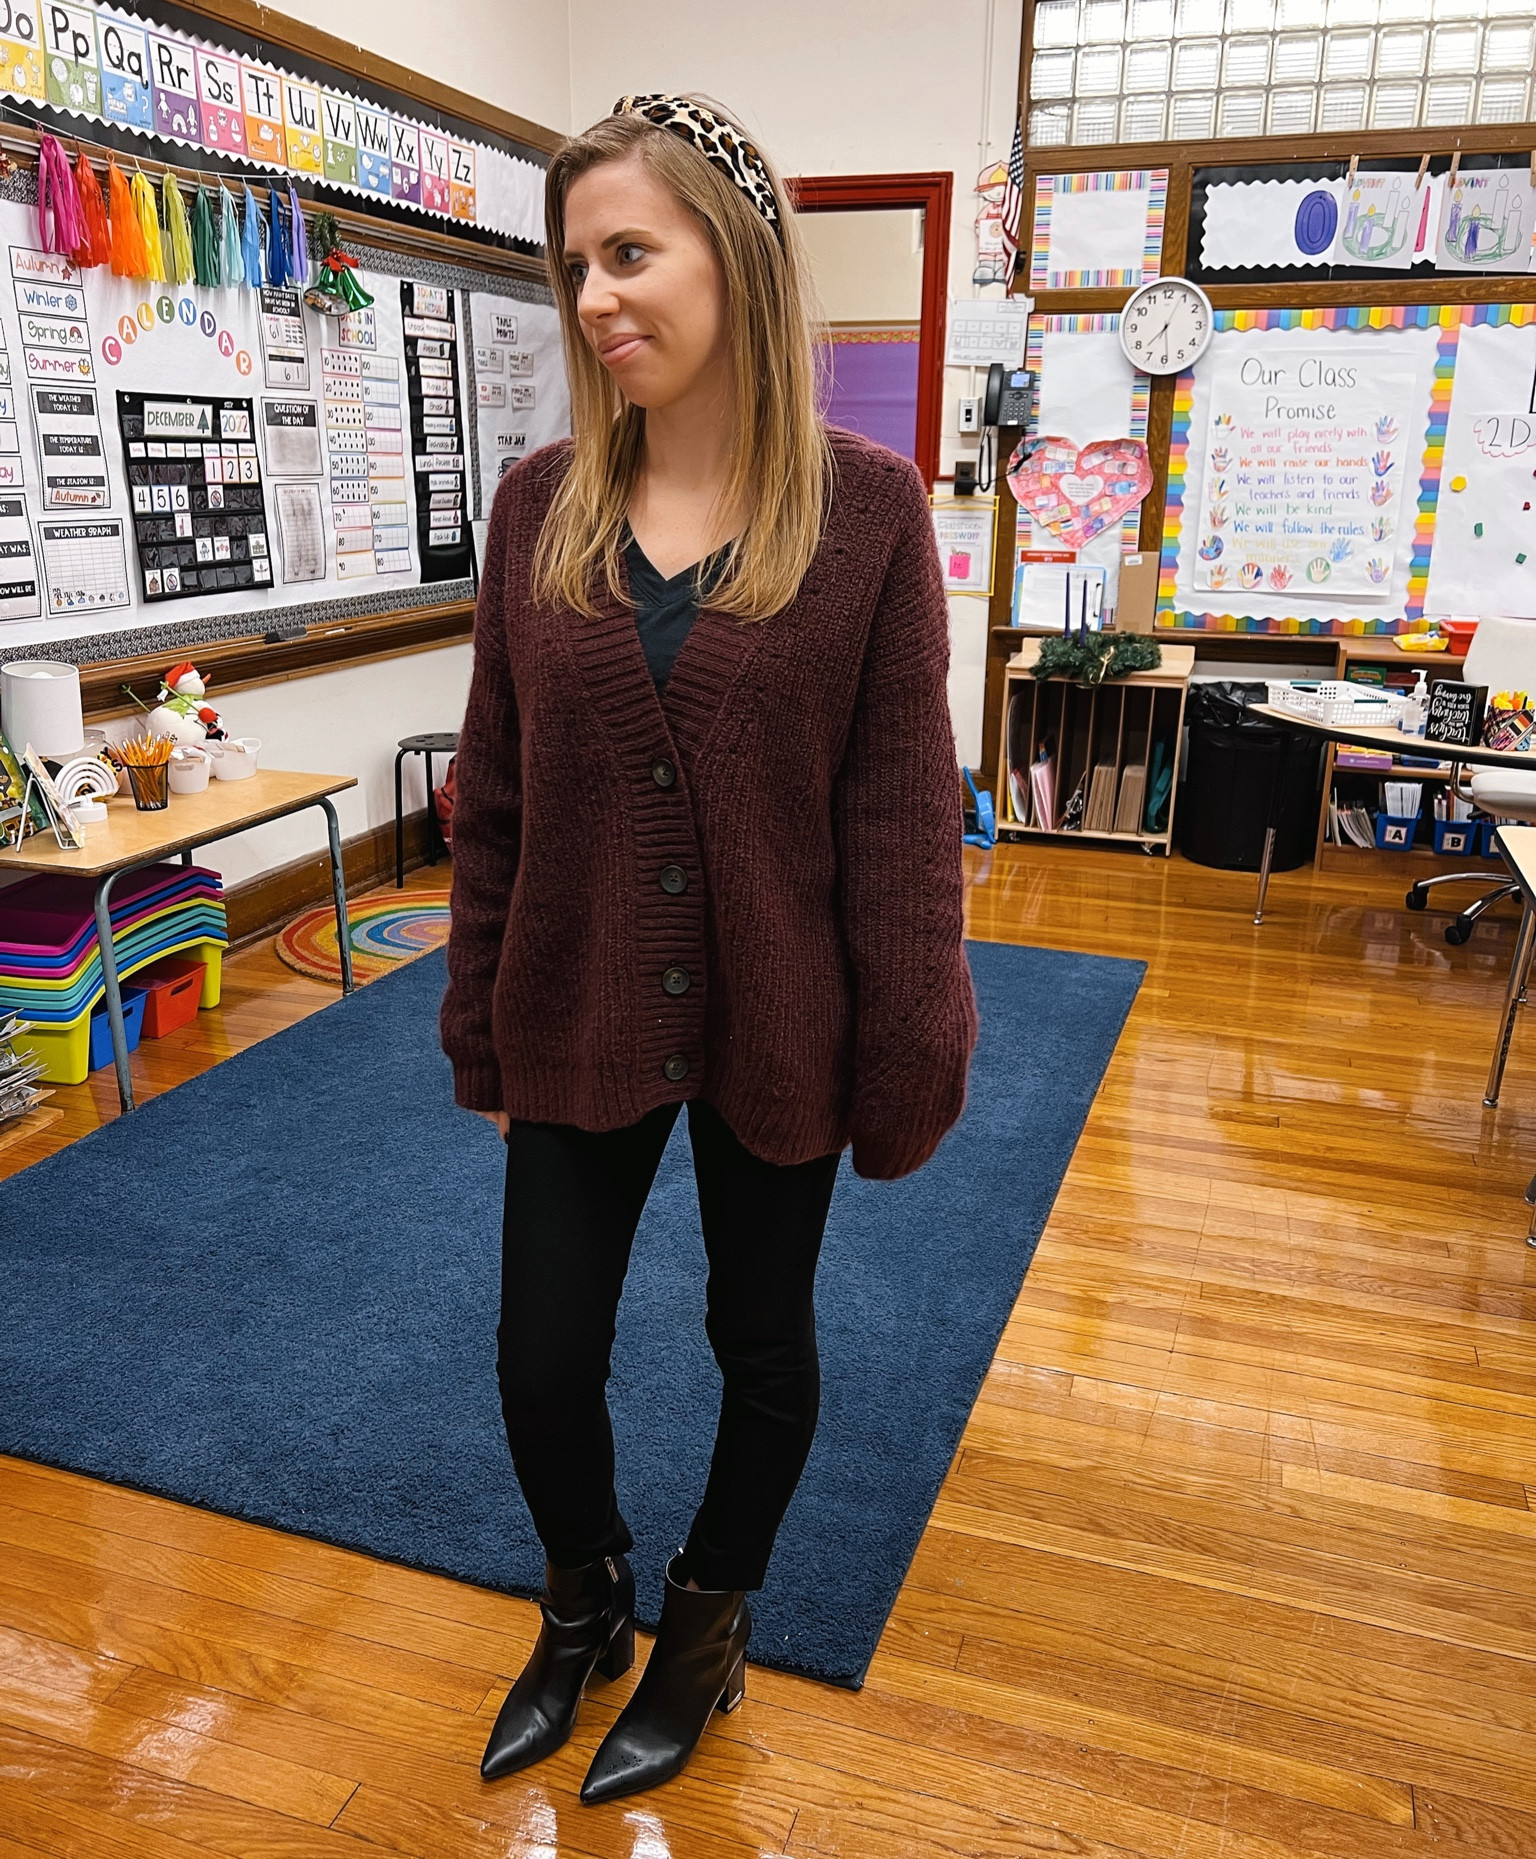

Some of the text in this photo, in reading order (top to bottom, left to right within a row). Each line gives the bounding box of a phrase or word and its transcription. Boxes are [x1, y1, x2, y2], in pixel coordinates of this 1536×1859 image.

[51, 6, 90, 67] Pp
[104, 26, 149, 89] Qq
[158, 44, 189, 88] Rr
[206, 60, 234, 104] Ss
[248, 74, 274, 117] Tt
[288, 86, 316, 131] Uu
[326, 100, 351, 141] Vv
[357, 111, 389, 153] Ww
[393, 125, 415, 164] Xx
[424, 137, 443, 181] Yy
[452, 149, 472, 183] Zz
[23, 288, 62, 308] Winter
[1146, 295, 1156, 305] 11
[1163, 289, 1175, 299] 12
[1181, 294, 1187, 303] 1
[1137, 307, 1148, 316] 10
[1191, 304, 1199, 314] 2
[1130, 323, 1138, 333] 9
[1195, 321, 1202, 330] 3
[28, 321, 68, 345] Spring
[342, 327, 375, 345] SCHOOL
[1135, 340, 1142, 350] 8
[1189, 338, 1196, 347] 4
[1146, 352, 1153, 361] 7
[1161, 355, 1168, 364] 6
[1177, 350, 1184, 359] 5
[28, 353, 76, 373] Summer
[1240, 357, 1358, 389] Our Class
[274, 403, 302, 414] QUESTION
[1264, 395, 1337, 420] Promise
[147, 411, 248, 433] DECEMBER 2022
[282, 416, 304, 426] THE DAY
[1240, 427, 1367, 443] We will play nicely with
[1486, 416, 1531, 448] 2D
[1250, 441, 1332, 454] all our friends
[331, 461, 340, 470] 50
[1239, 456, 1368, 468] We will raise our hands
[227, 461, 235, 479] 2
[244, 461, 253, 479] 3
[1236, 473, 1358, 485] We will listen to our
[54, 490, 89, 503] Autumn
[333, 486, 340, 496] 60
[1249, 488, 1360, 501] teachers and friends
[139, 488, 185, 508] 4 5 6
[1235, 502, 1333, 516] We will be kind
[335, 512, 342, 522] 70
[52, 526, 112, 538] WEATHER GRAPH
[1233, 518, 1364, 535] We will follow the rules
[338, 537, 345, 547] 80
[10, 544, 30, 554] WAS:
[1427, 722, 1466, 743] teachers
[1392, 829, 1403, 840] A
[1450, 836, 1461, 847] B
